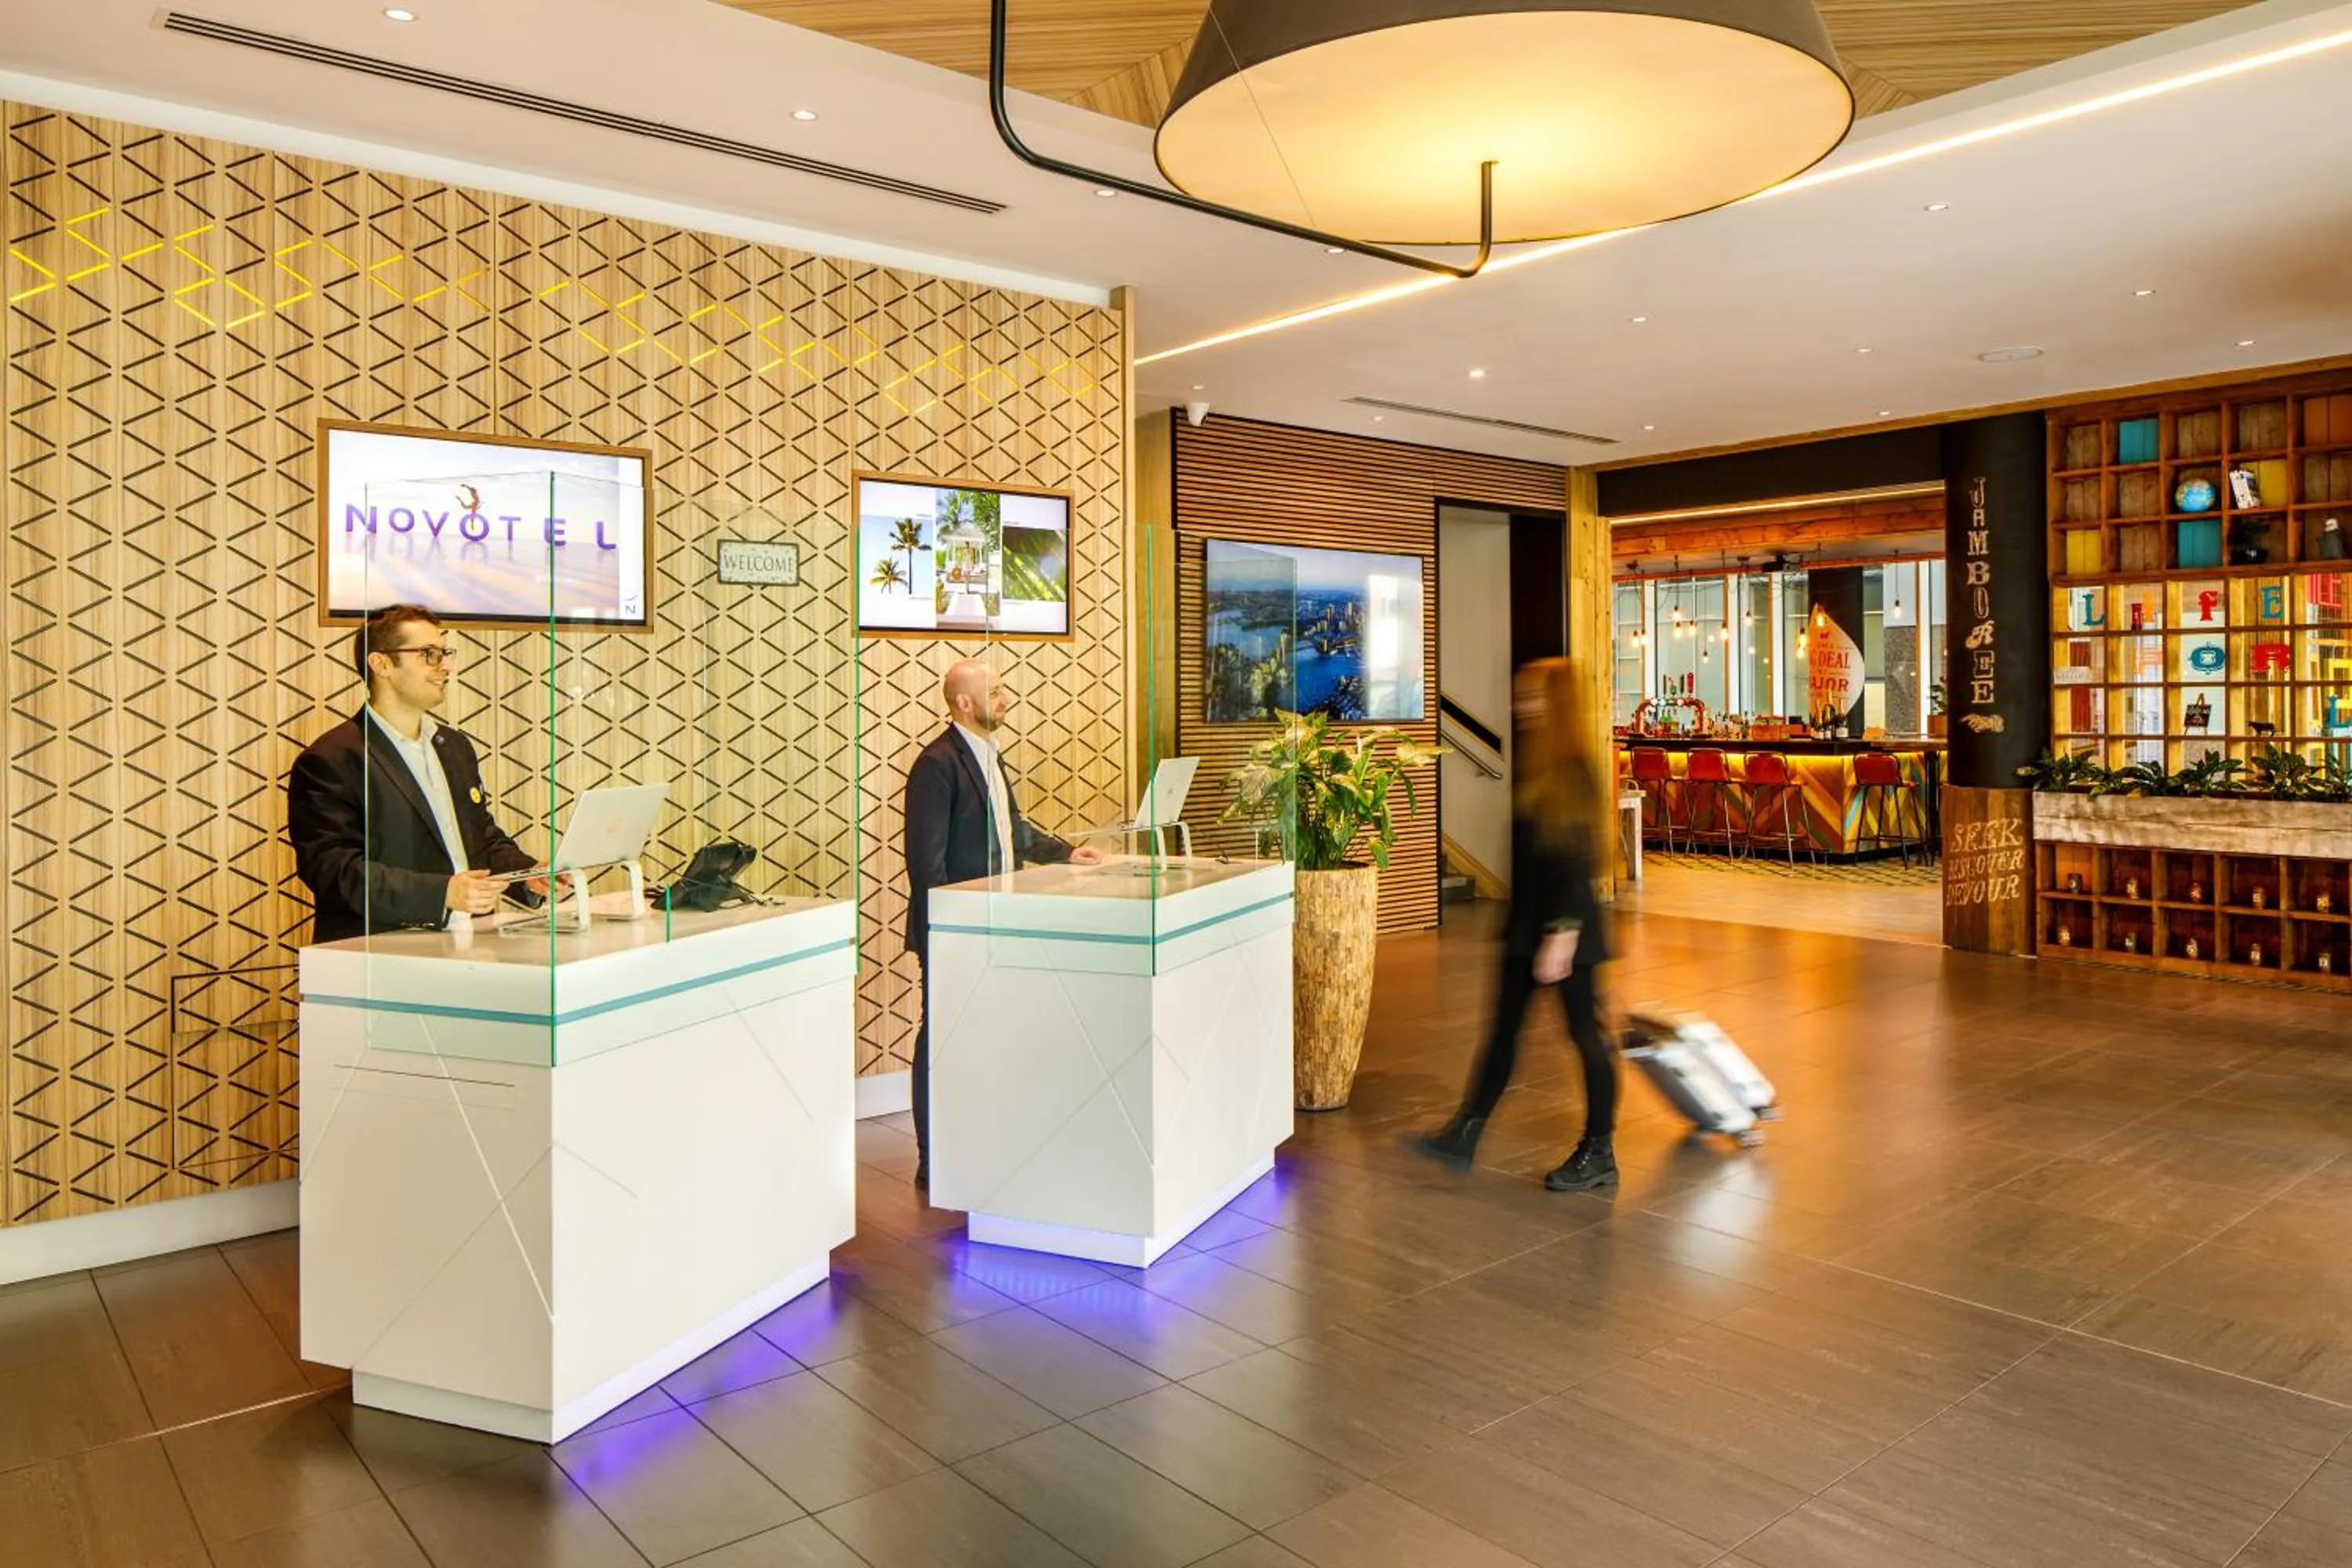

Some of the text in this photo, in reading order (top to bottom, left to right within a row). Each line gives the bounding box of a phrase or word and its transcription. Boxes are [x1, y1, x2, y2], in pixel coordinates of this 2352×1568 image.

[345, 503, 617, 550] NOVOTEL
[724, 554, 794, 573] WELCOME
[1965, 476, 1996, 704] JAMBOREE
[1950, 818, 2024, 852] SEEK
[1946, 874, 2020, 906] DEVOUR
